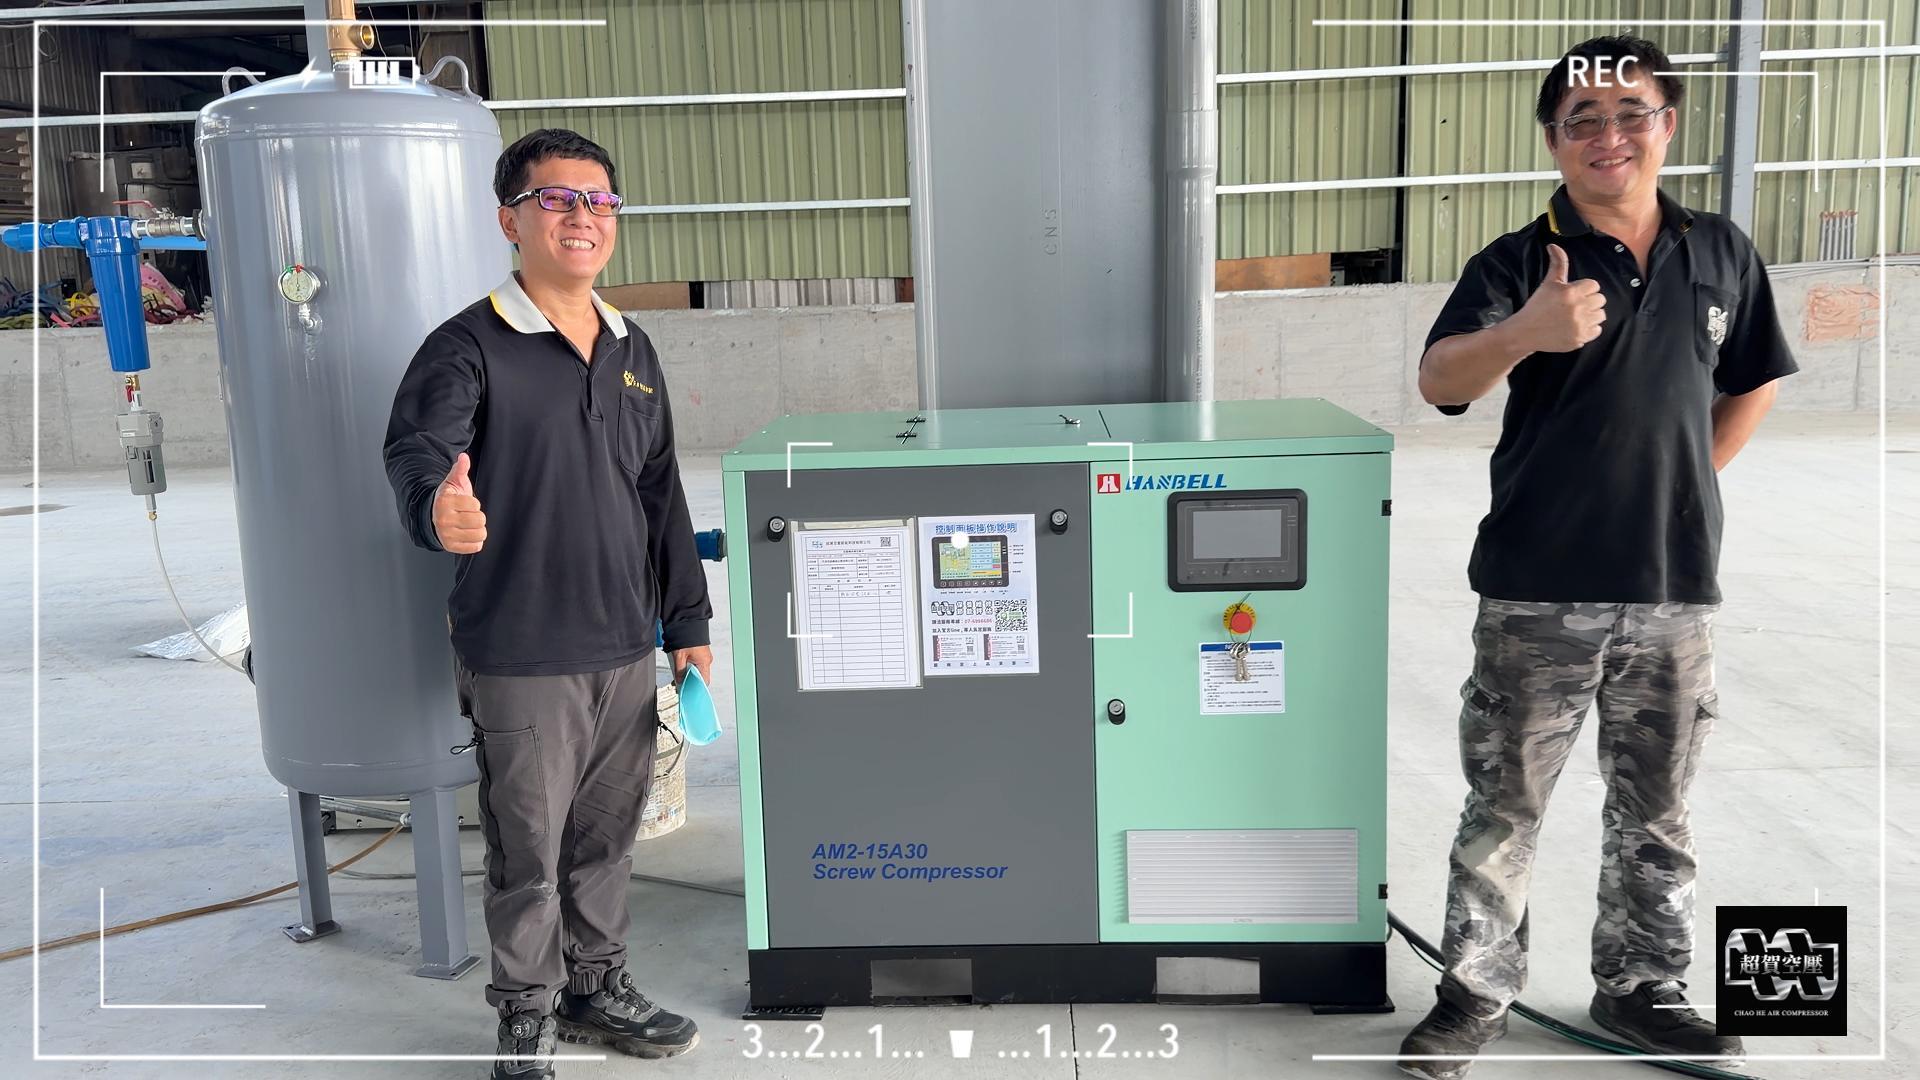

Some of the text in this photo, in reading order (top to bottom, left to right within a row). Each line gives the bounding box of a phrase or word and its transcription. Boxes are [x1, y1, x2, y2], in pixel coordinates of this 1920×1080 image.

[1044, 208, 1057, 255] CNS
[1125, 474, 1227, 490] HANBELL
[935, 522, 1017, 534] 控制面板操作說明
[811, 843, 928, 859] AM2-15A30
[813, 863, 1008, 882] Screw Compressor
